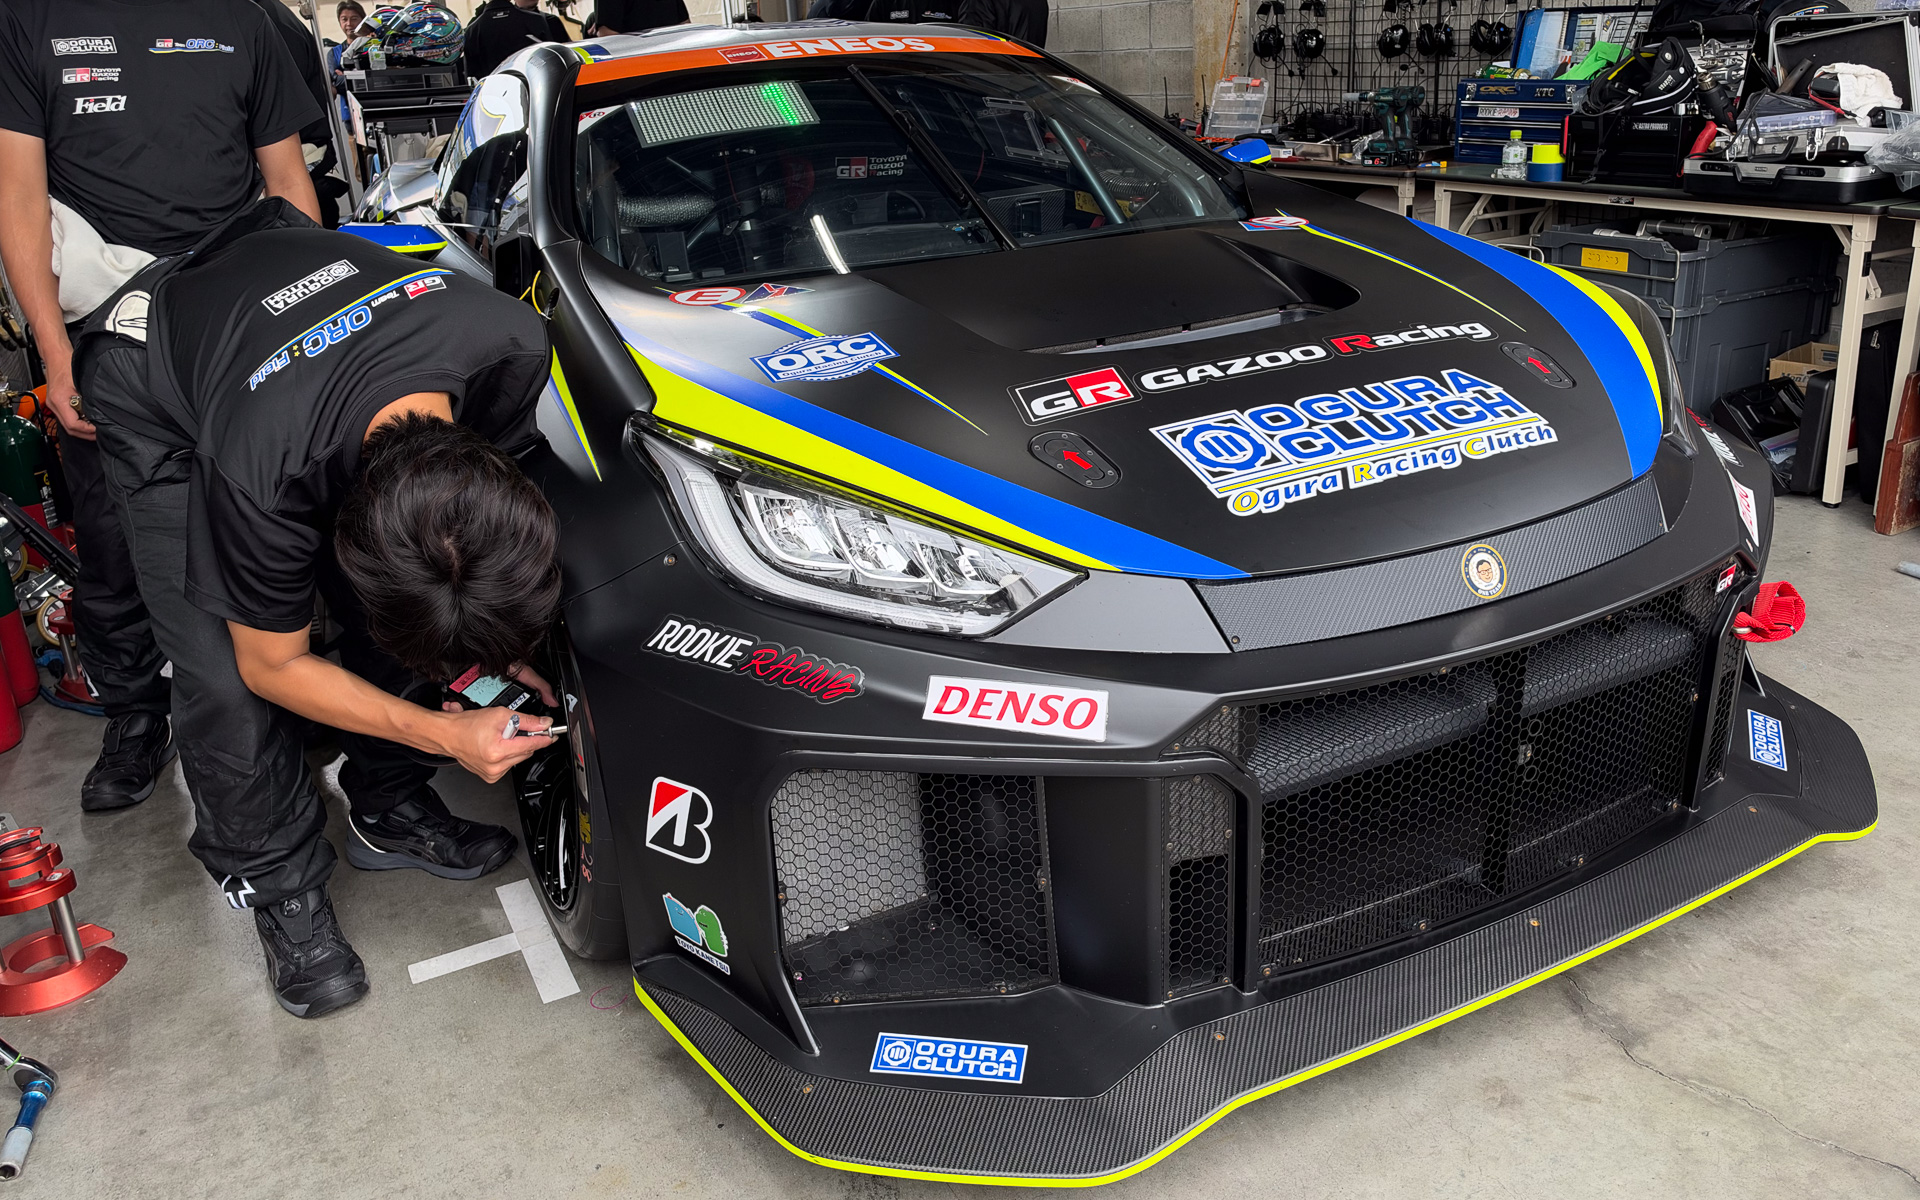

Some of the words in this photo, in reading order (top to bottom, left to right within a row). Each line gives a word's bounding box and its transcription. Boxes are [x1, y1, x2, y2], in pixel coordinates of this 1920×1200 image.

[186, 38, 215, 49] ORC
[762, 37, 935, 58] ENEOS
[64, 73, 90, 83] GR
[72, 95, 127, 115] Field
[836, 165, 866, 178] GR
[869, 154, 908, 164] TOYOTA
[869, 162, 905, 170] GAZOO
[869, 168, 904, 177] Racing
[267, 270, 328, 306] CLUTCH
[272, 275, 334, 310] OGURA
[371, 289, 400, 307] Team
[405, 276, 441, 293] GR
[685, 290, 723, 302] E
[302, 305, 372, 358] ORC
[767, 337, 877, 371] ORC
[782, 367, 812, 377] Ogura
[814, 359, 849, 370] Racing
[850, 352, 882, 362] Clutch
[249, 350, 291, 391] Field
[1030, 383, 1125, 417] GR
[1140, 345, 1328, 391] GAZOO
[1330, 321, 1493, 354] Racing
[1246, 370, 1498, 433] OGURA
[1275, 391, 1529, 461] CLUTCH
[1233, 474, 1340, 514] Ogura
[1353, 446, 1458, 484] Racing
[1464, 425, 1553, 457] Clutch
[647, 619, 753, 669] ROOKIE
[740, 648, 856, 700] RACING
[932, 685, 1098, 730] DENSO
[1752, 714, 1768, 750] OGURA
[1765, 717, 1781, 755] CLUTCH
[912, 1055, 1017, 1078] CLUTCH
[915, 1041, 1018, 1063] OGURA
